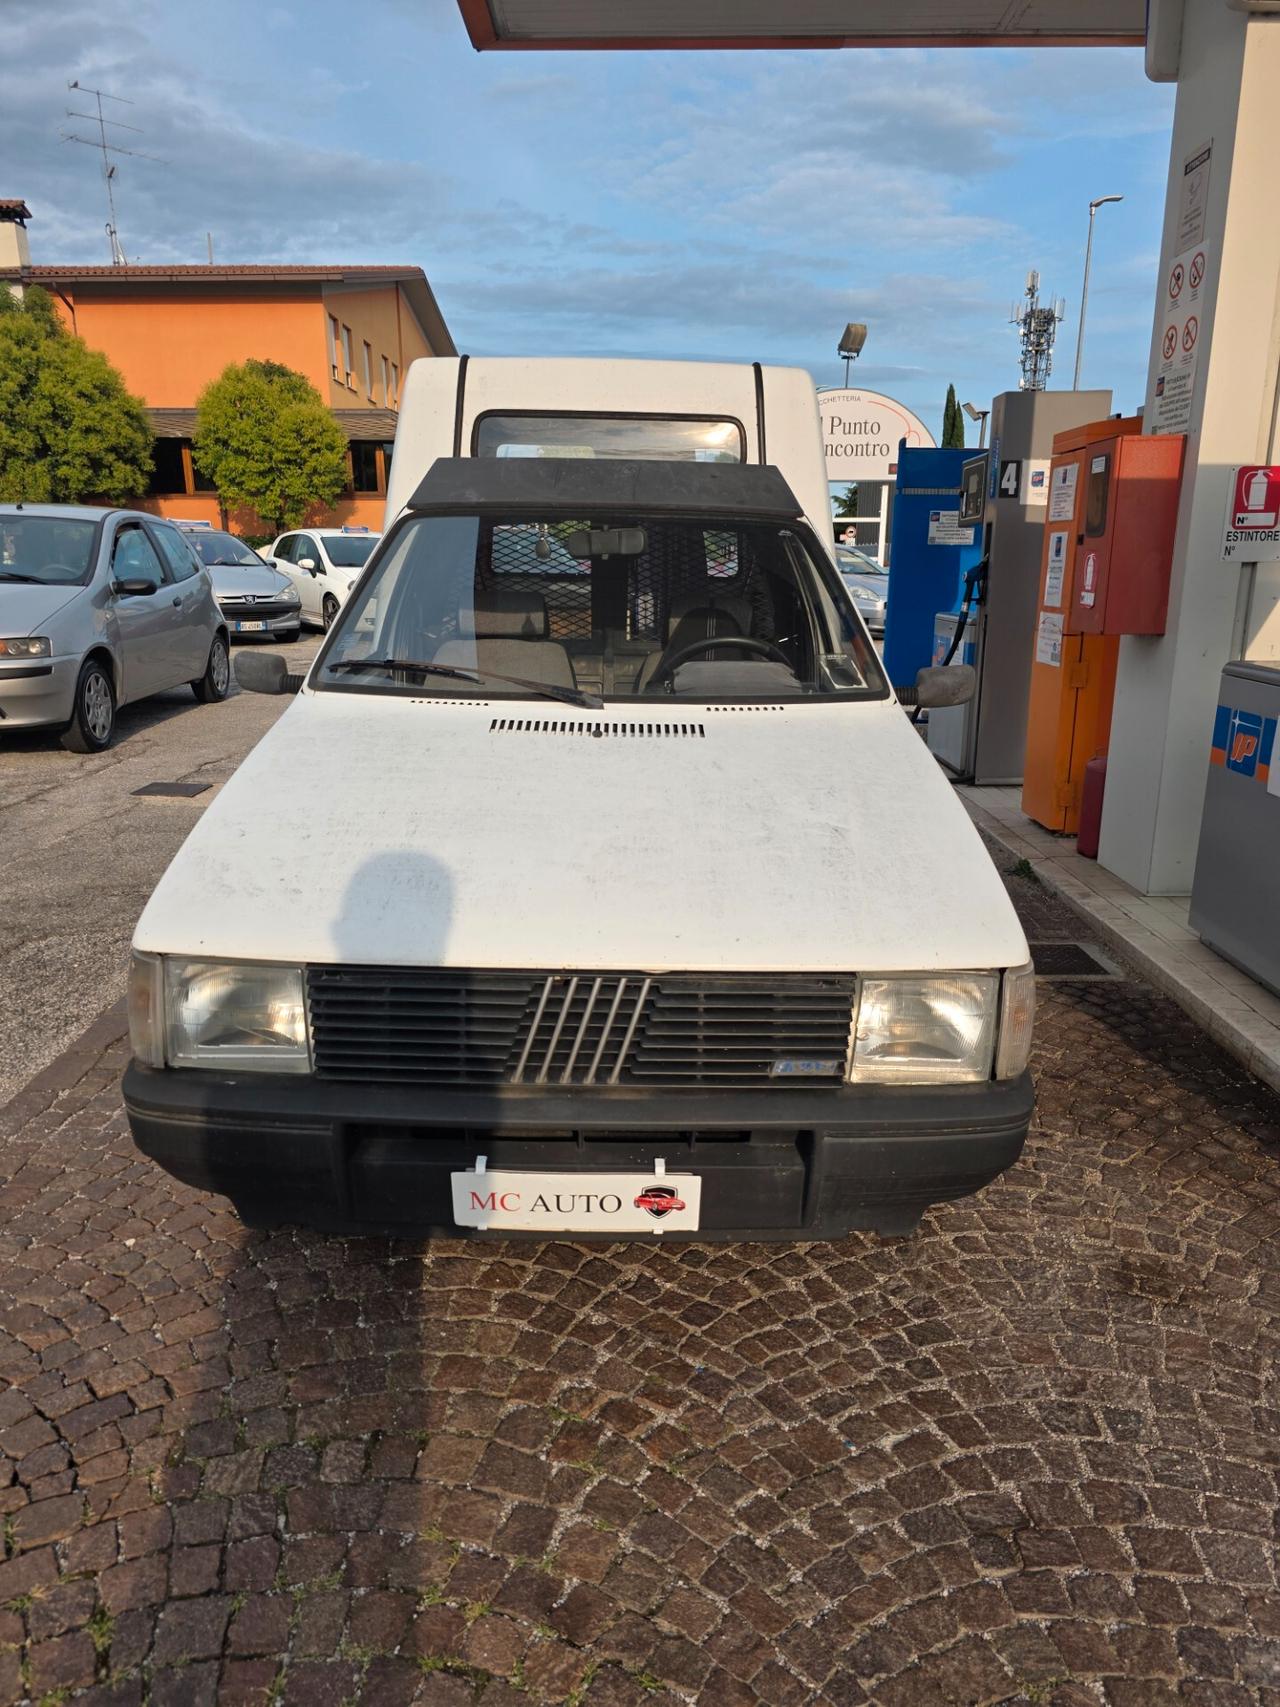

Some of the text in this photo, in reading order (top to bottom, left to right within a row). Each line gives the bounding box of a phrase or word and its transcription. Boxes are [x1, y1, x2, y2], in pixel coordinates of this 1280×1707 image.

[819, 395, 861, 406] CCHETTERIA
[828, 416, 881, 435] Punto
[825, 442, 890, 457] ncontro
[1001, 463, 1017, 495] 4
[1226, 531, 1280, 542] ESTINTORE
[1224, 546, 1236, 556] N°
[470, 1191, 622, 1213] MC AUTO
